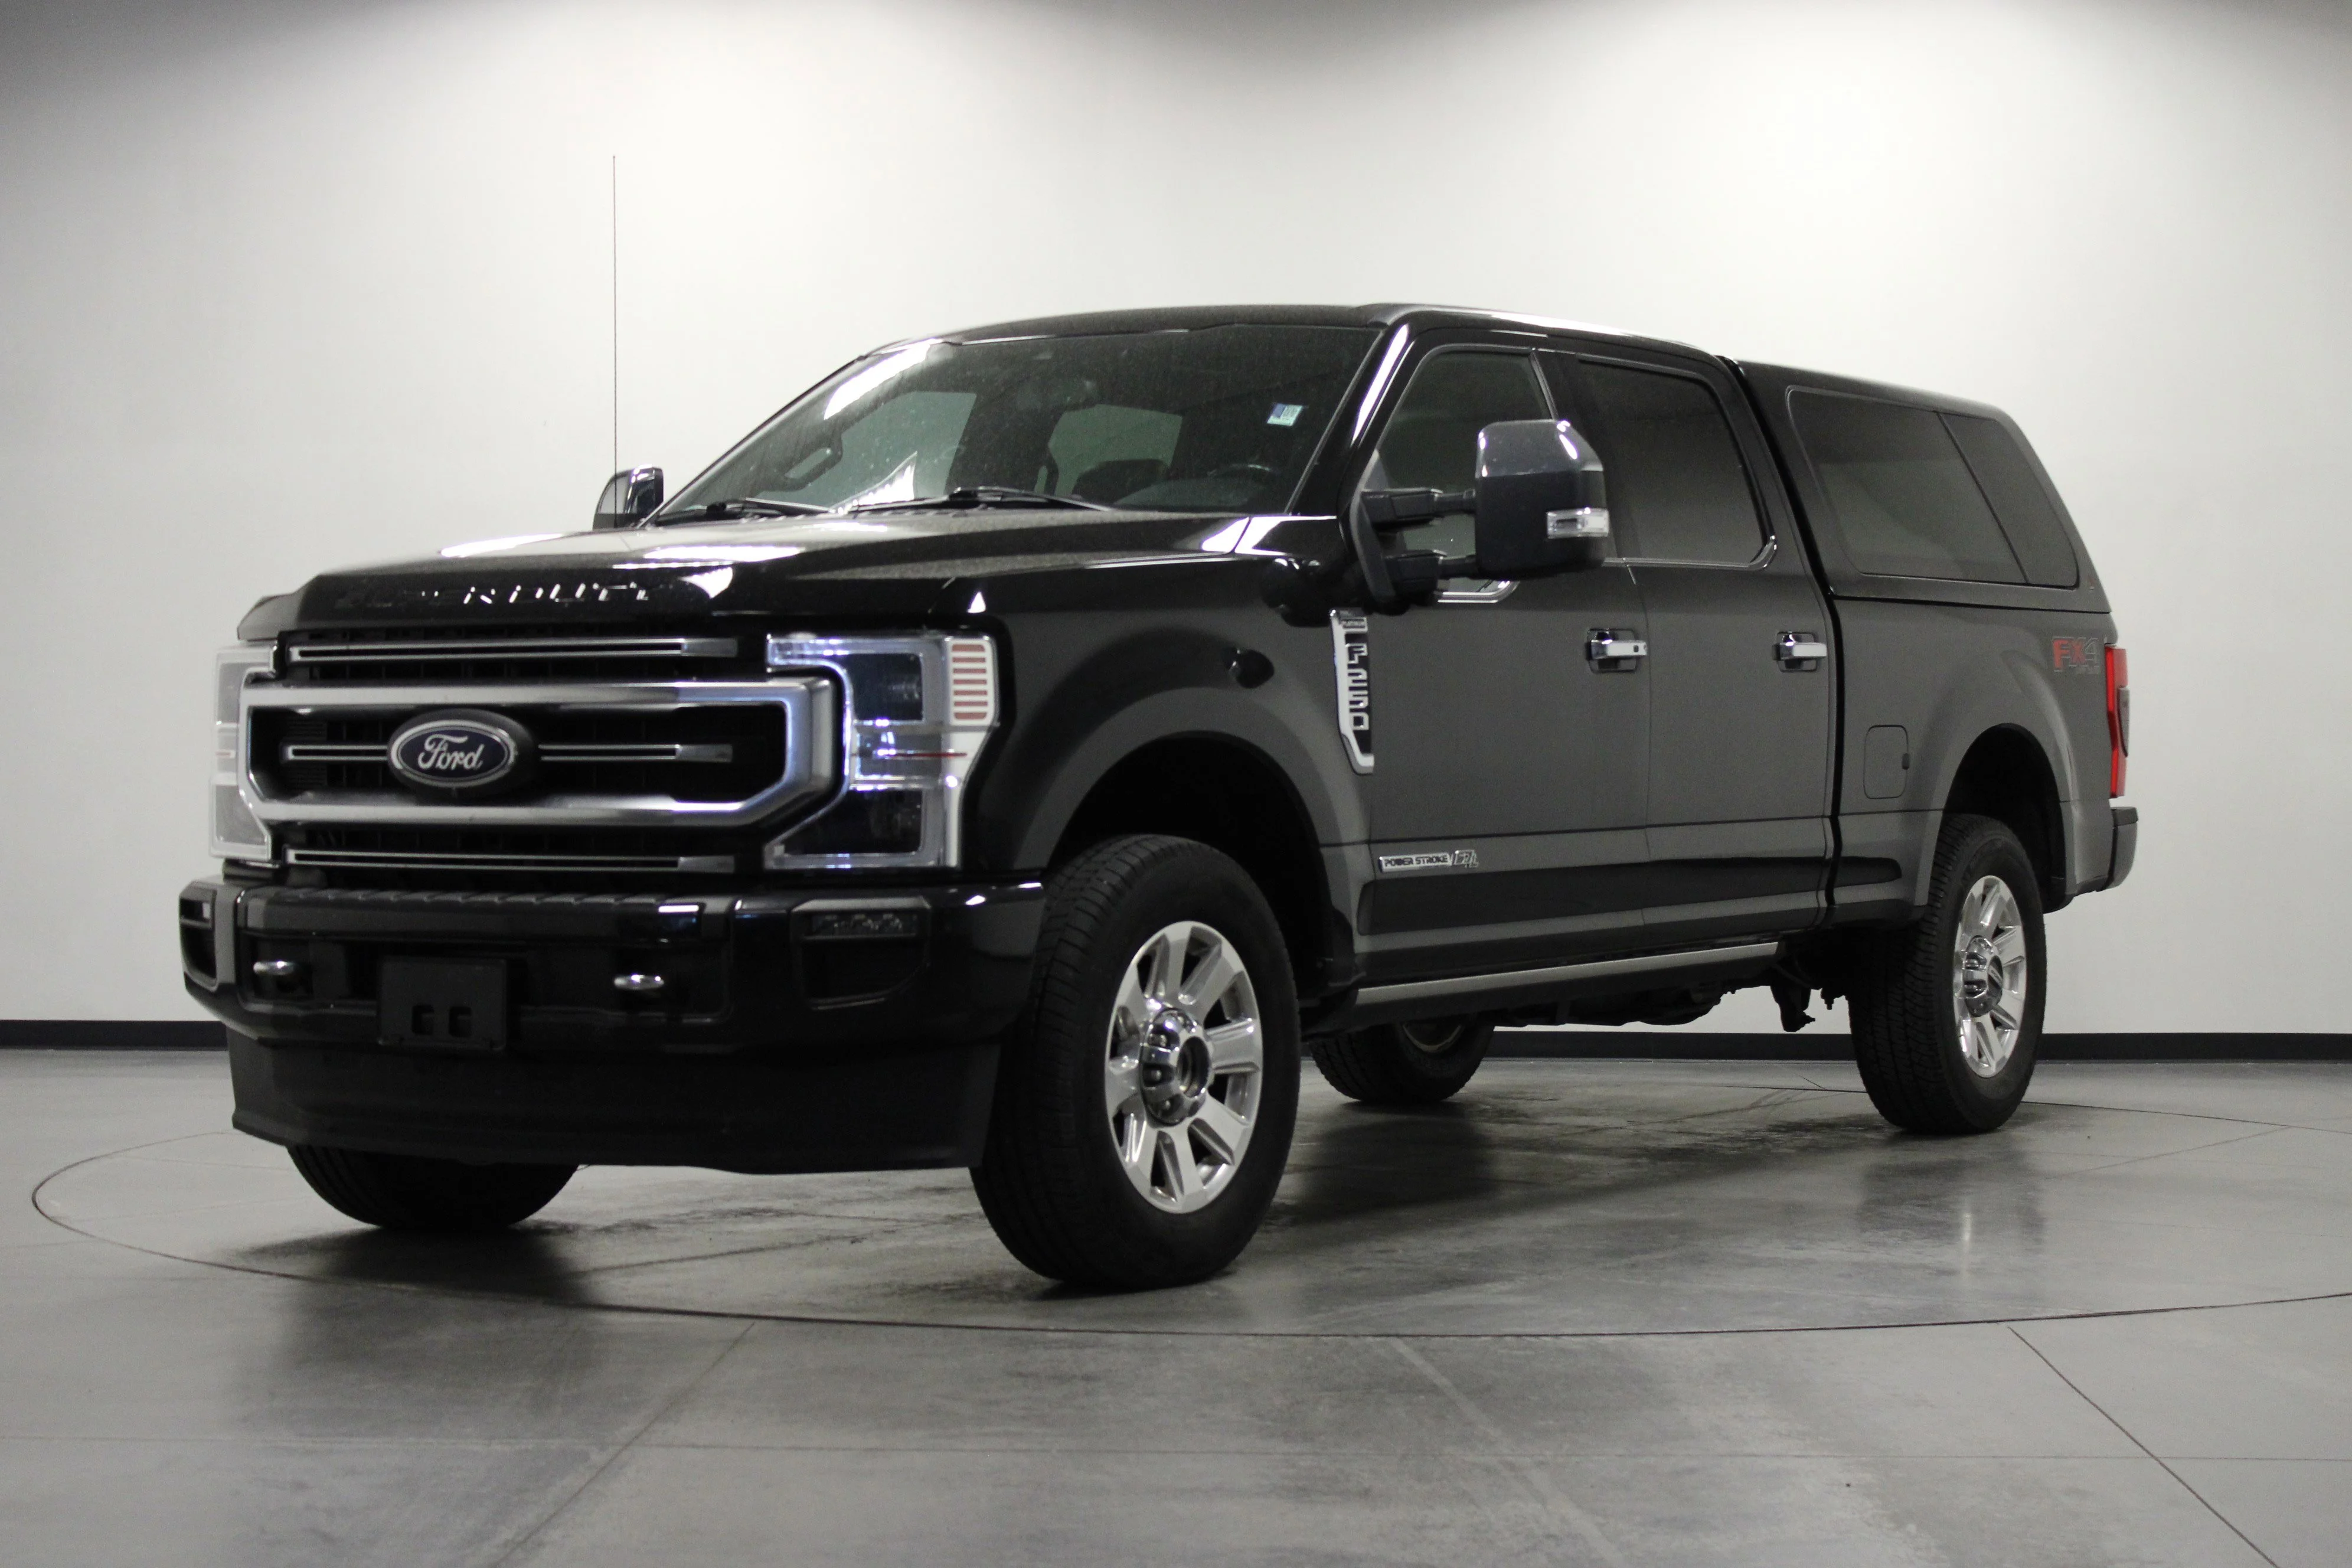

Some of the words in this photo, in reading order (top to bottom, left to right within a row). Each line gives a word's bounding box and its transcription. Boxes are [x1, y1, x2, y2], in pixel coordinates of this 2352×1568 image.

[2052, 636, 2100, 672] FX4
[417, 733, 485, 770] Ford
[1384, 857, 1413, 867] POWER
[1415, 855, 1448, 865] STROKE
